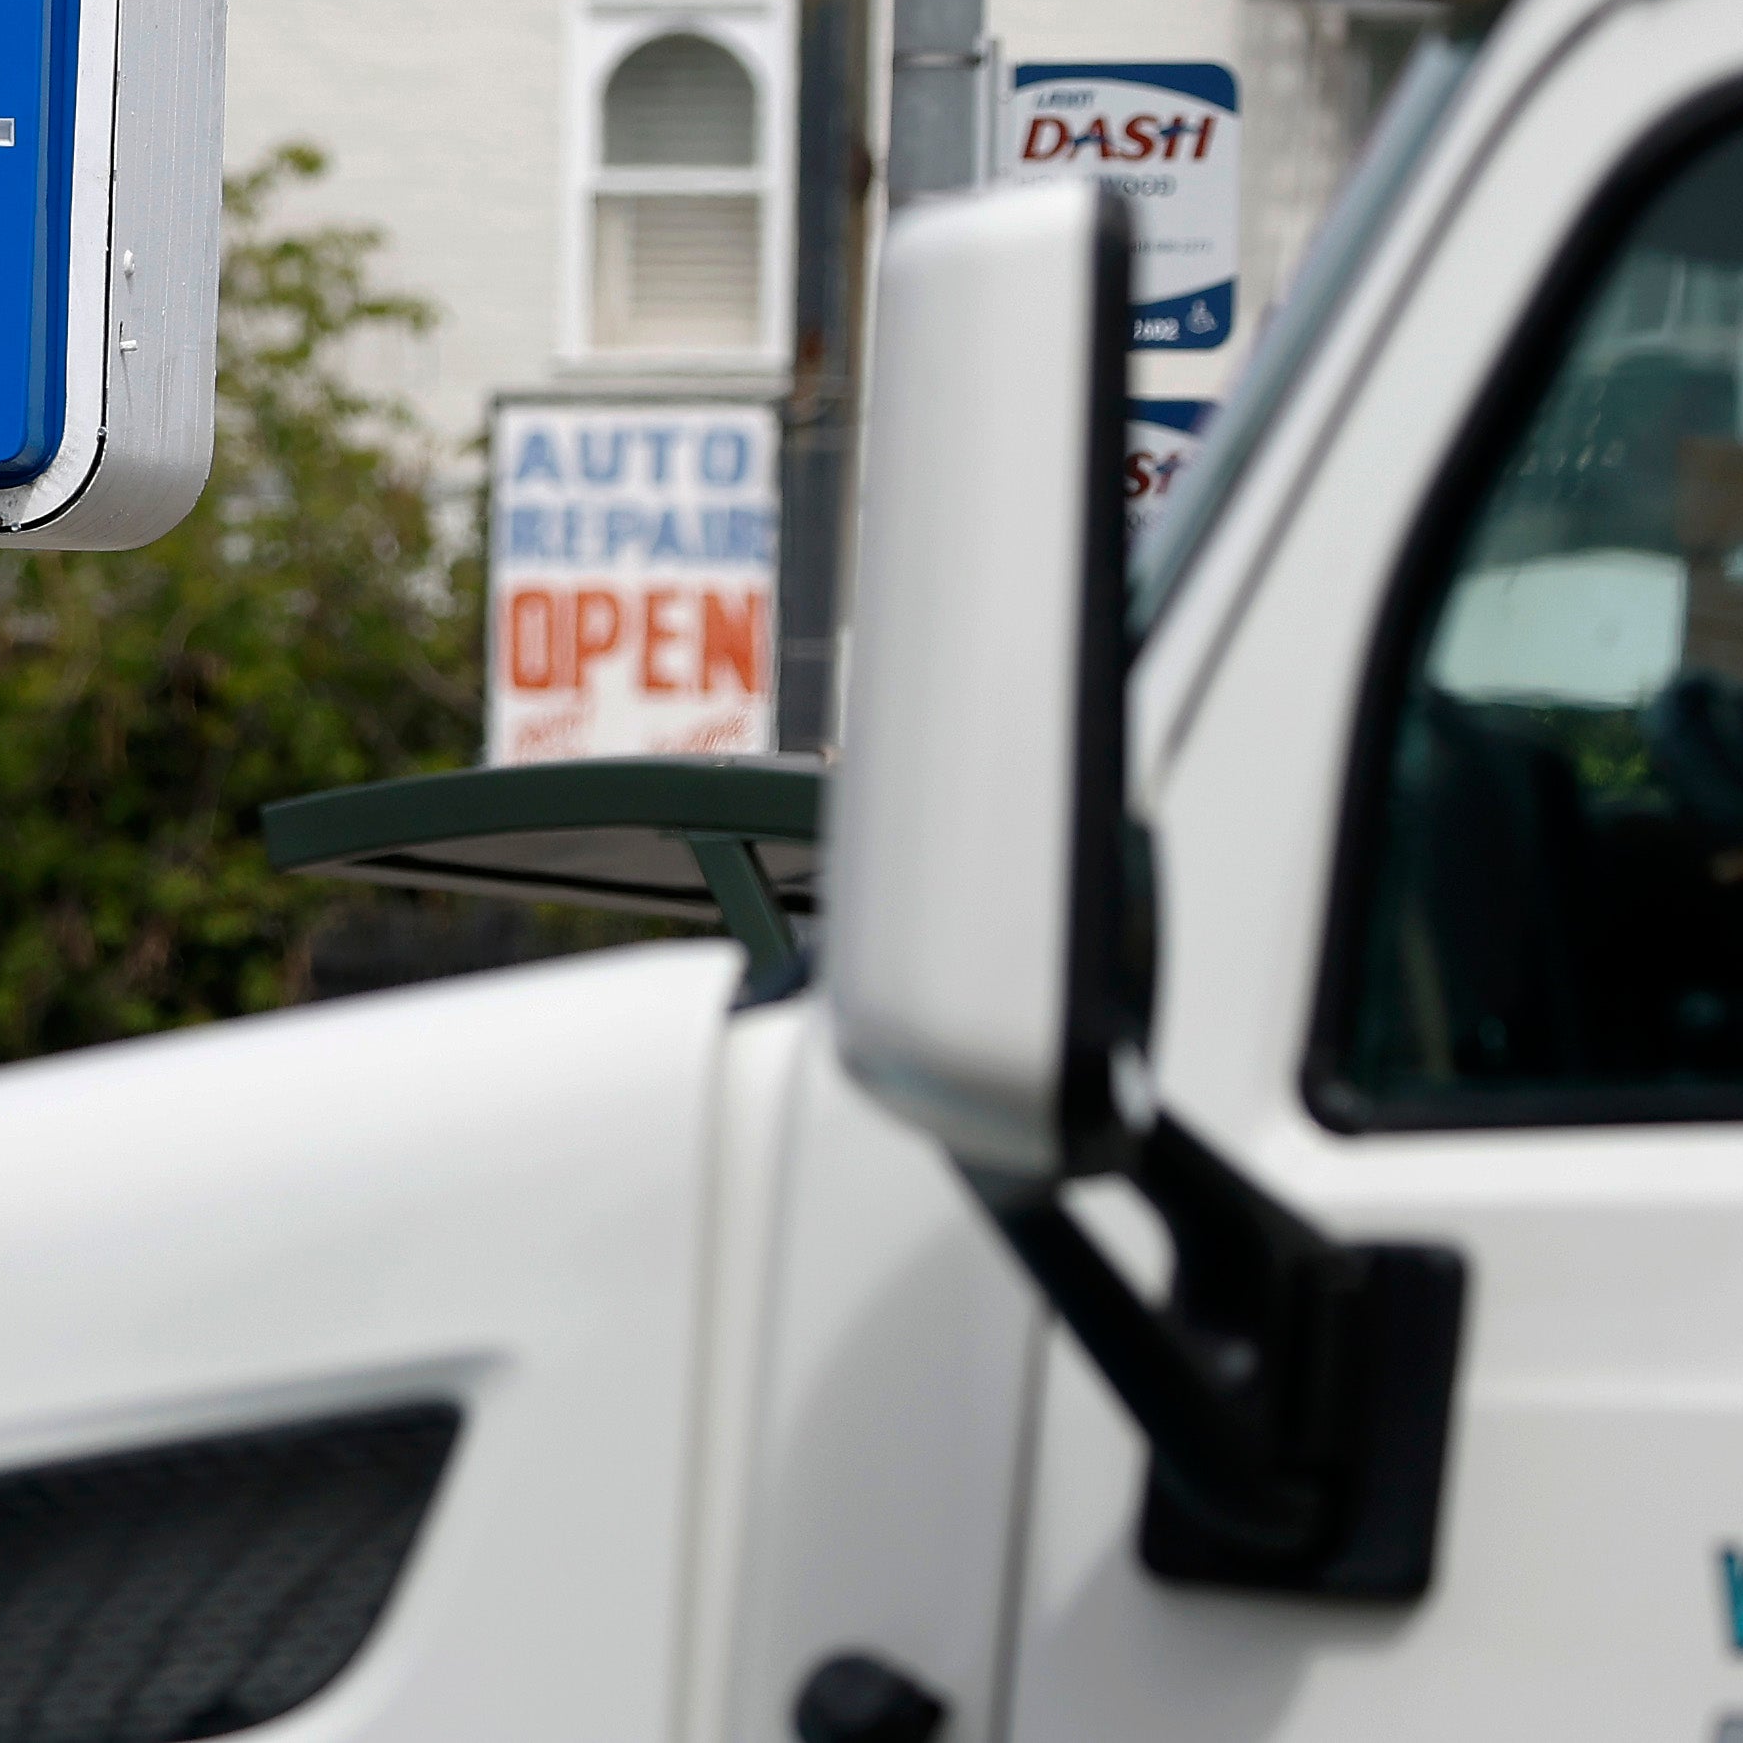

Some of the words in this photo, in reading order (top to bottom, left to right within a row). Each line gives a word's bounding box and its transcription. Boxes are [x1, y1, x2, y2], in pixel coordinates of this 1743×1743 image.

[1021, 114, 1217, 164] DASH
[512, 426, 753, 489] AUTO
[506, 585, 767, 697] OPEN
